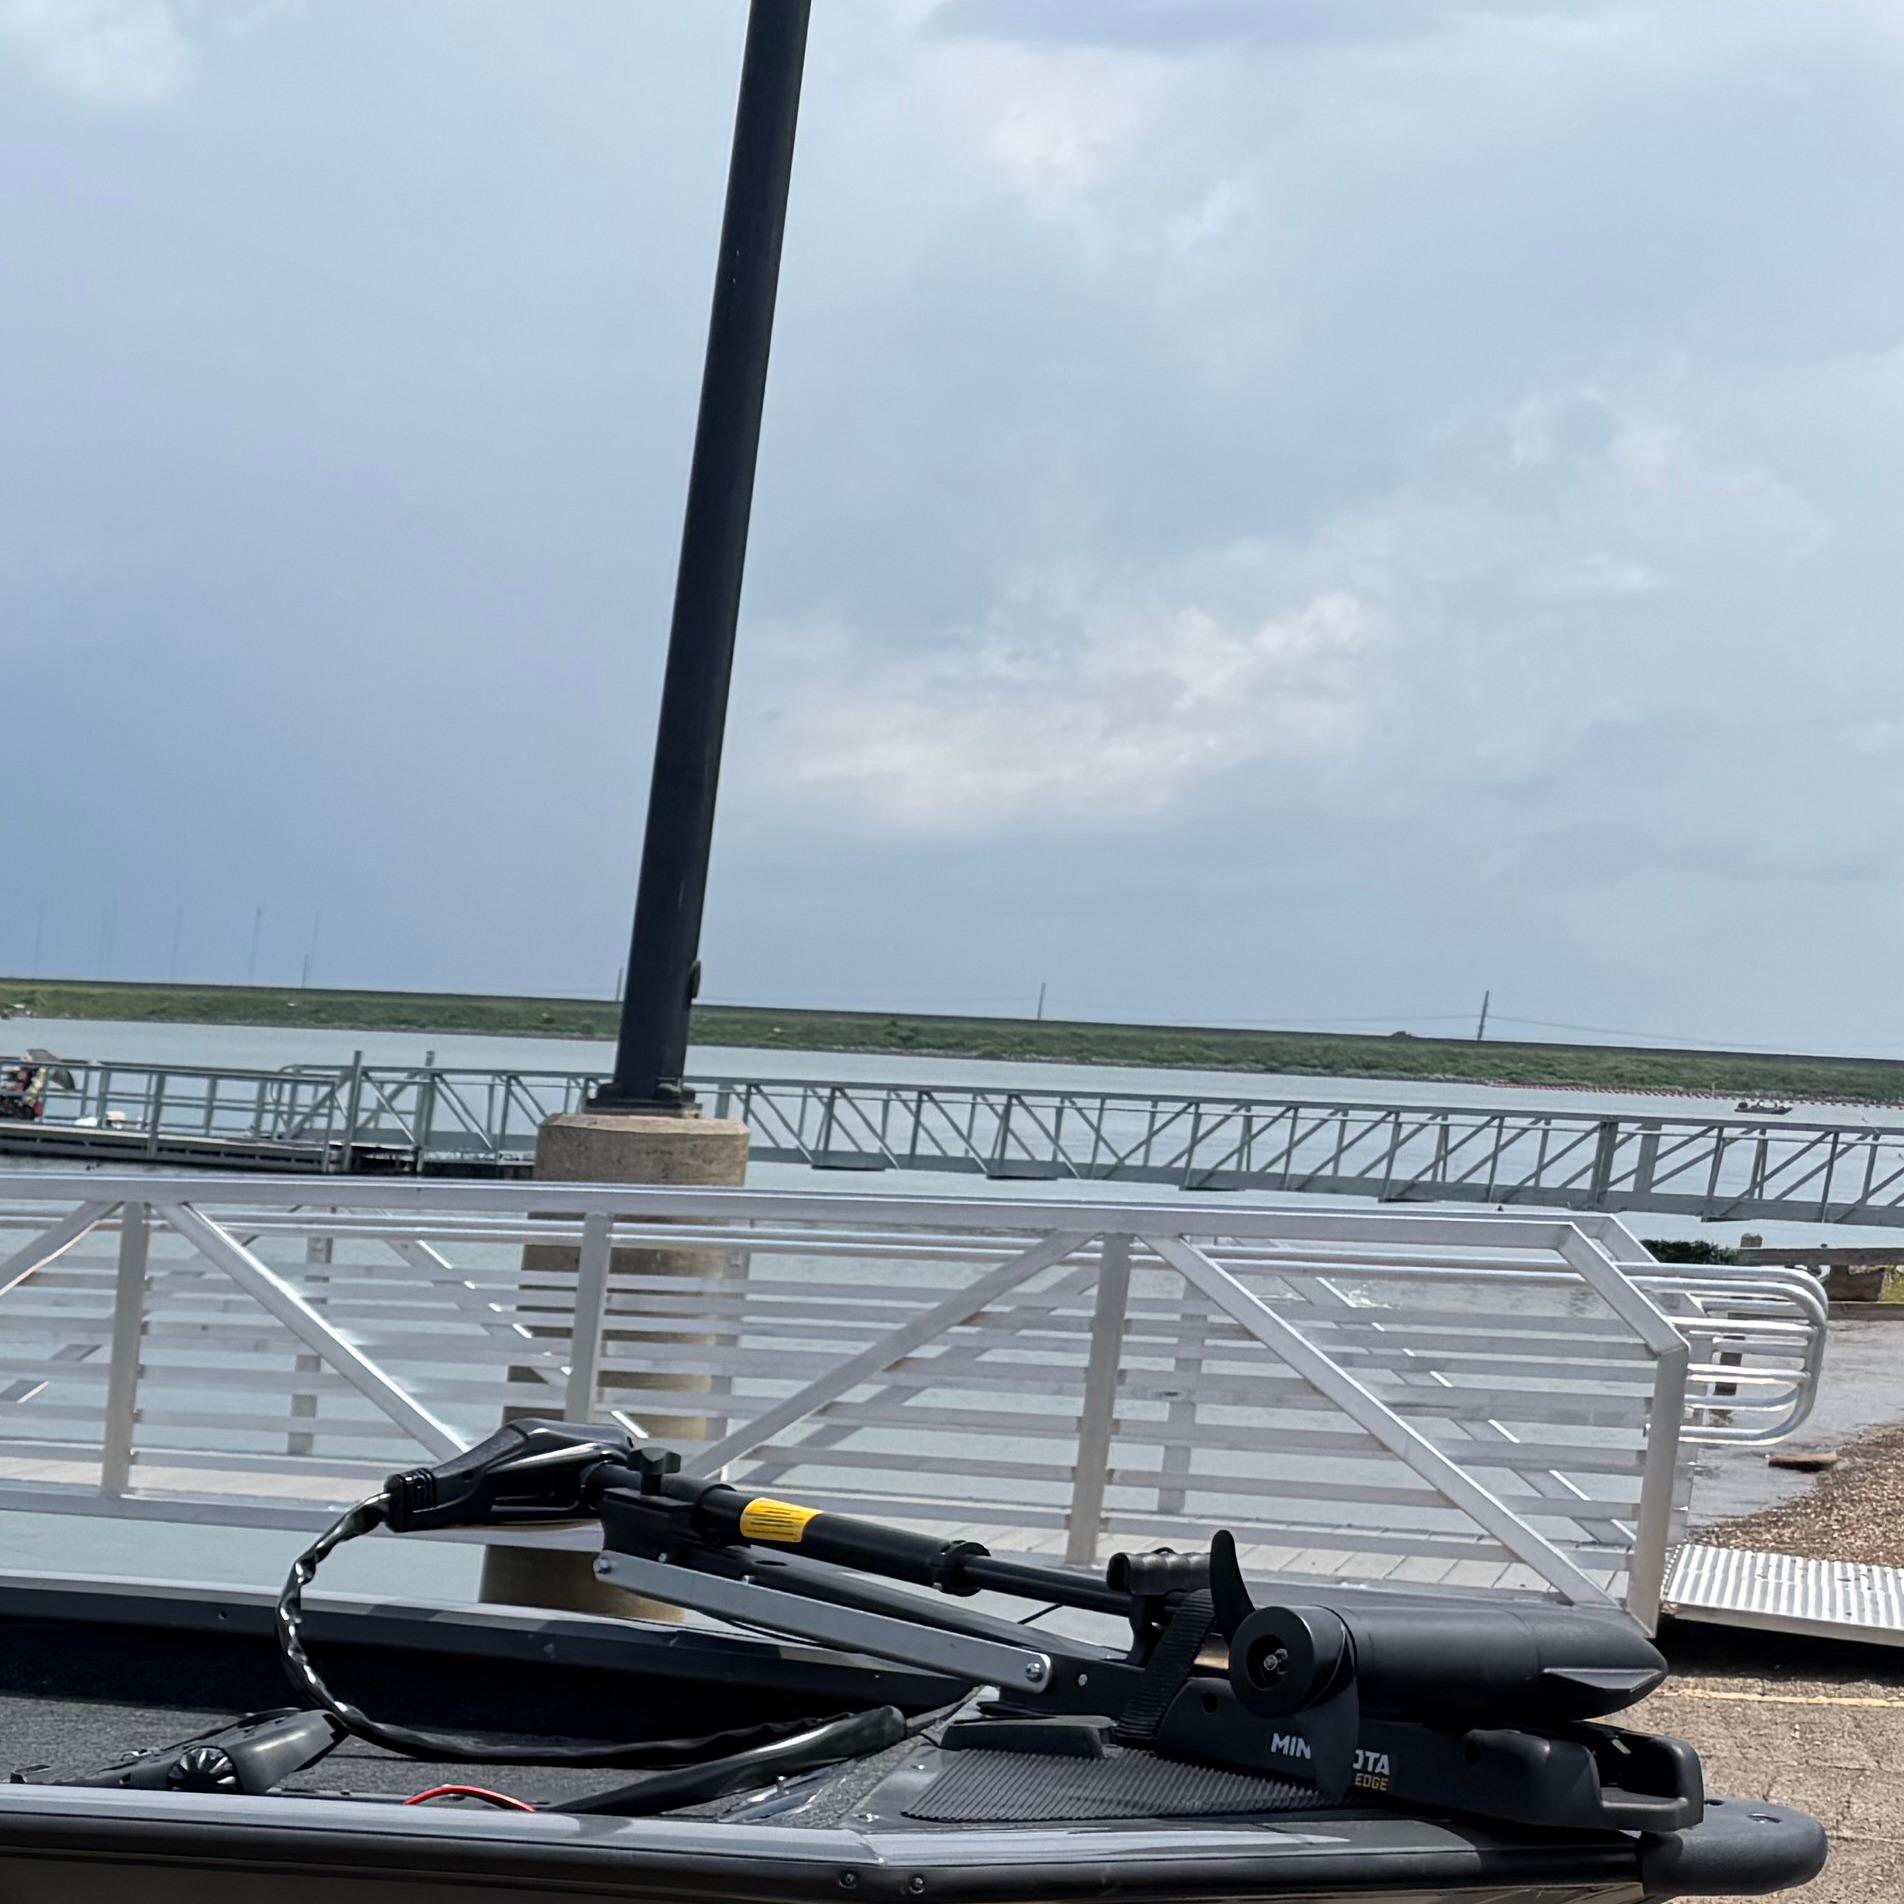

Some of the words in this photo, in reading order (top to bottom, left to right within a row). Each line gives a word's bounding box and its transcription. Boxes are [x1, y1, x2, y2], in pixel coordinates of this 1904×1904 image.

[1270, 1732, 1312, 1760] MIN
[1352, 1749, 1391, 1776] OTA
[1354, 1772, 1389, 1791] EDGE
